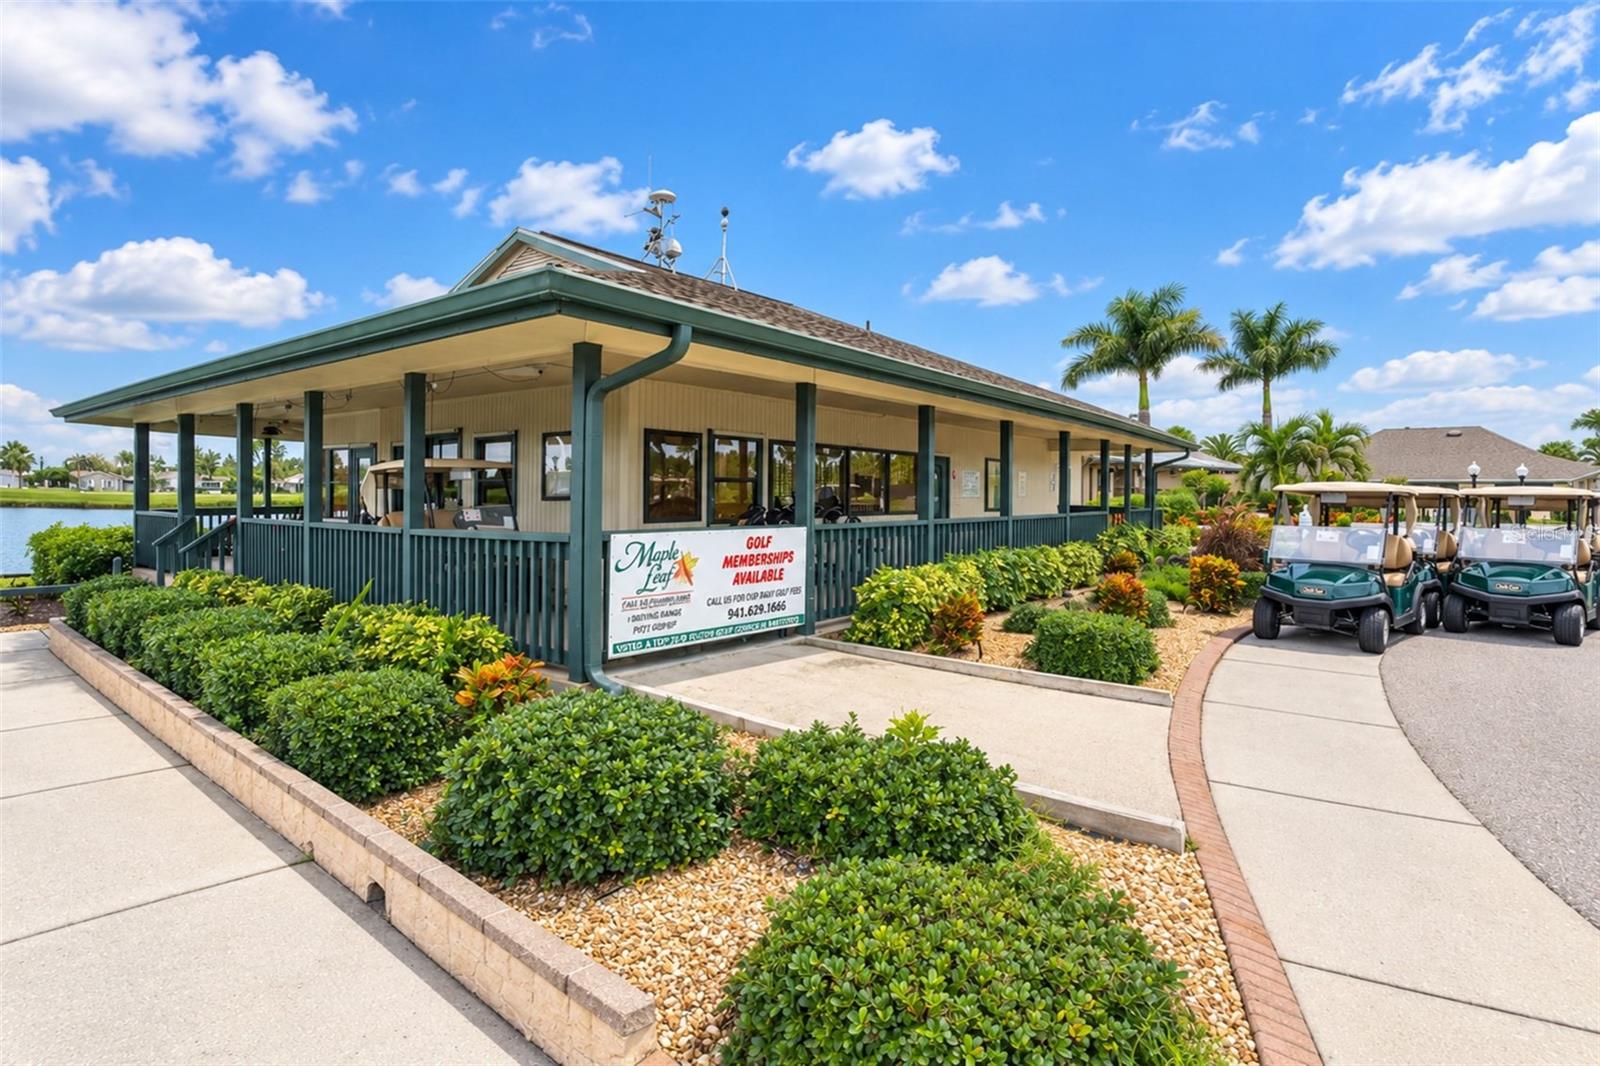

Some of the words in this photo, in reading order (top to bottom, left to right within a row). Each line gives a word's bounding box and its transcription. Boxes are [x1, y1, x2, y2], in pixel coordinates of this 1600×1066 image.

[746, 535, 773, 550] GOLF
[614, 540, 679, 573] Maple
[722, 550, 795, 569] MEMBERSHIPS
[636, 562, 677, 595] Leaf
[732, 568, 785, 586] AVAILABLE
[706, 596, 722, 607] CALL
[727, 600, 787, 620] 941.629.1666
